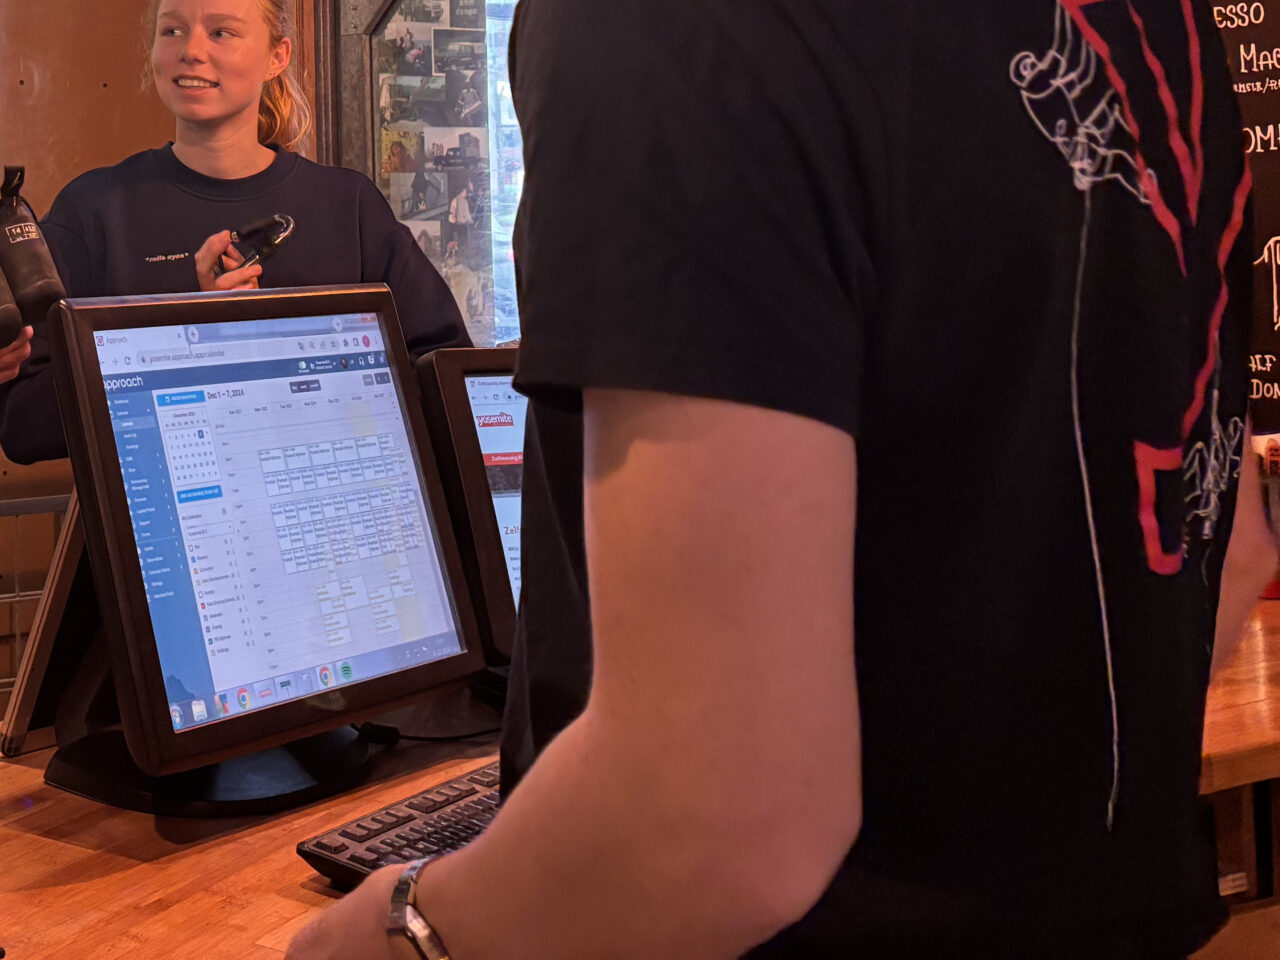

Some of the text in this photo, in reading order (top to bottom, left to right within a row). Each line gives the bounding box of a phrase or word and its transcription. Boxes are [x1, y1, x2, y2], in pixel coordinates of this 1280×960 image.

[1213, 2, 1265, 28] ESSO
[11, 227, 21, 235] 14
[477, 411, 513, 428] yosemite
